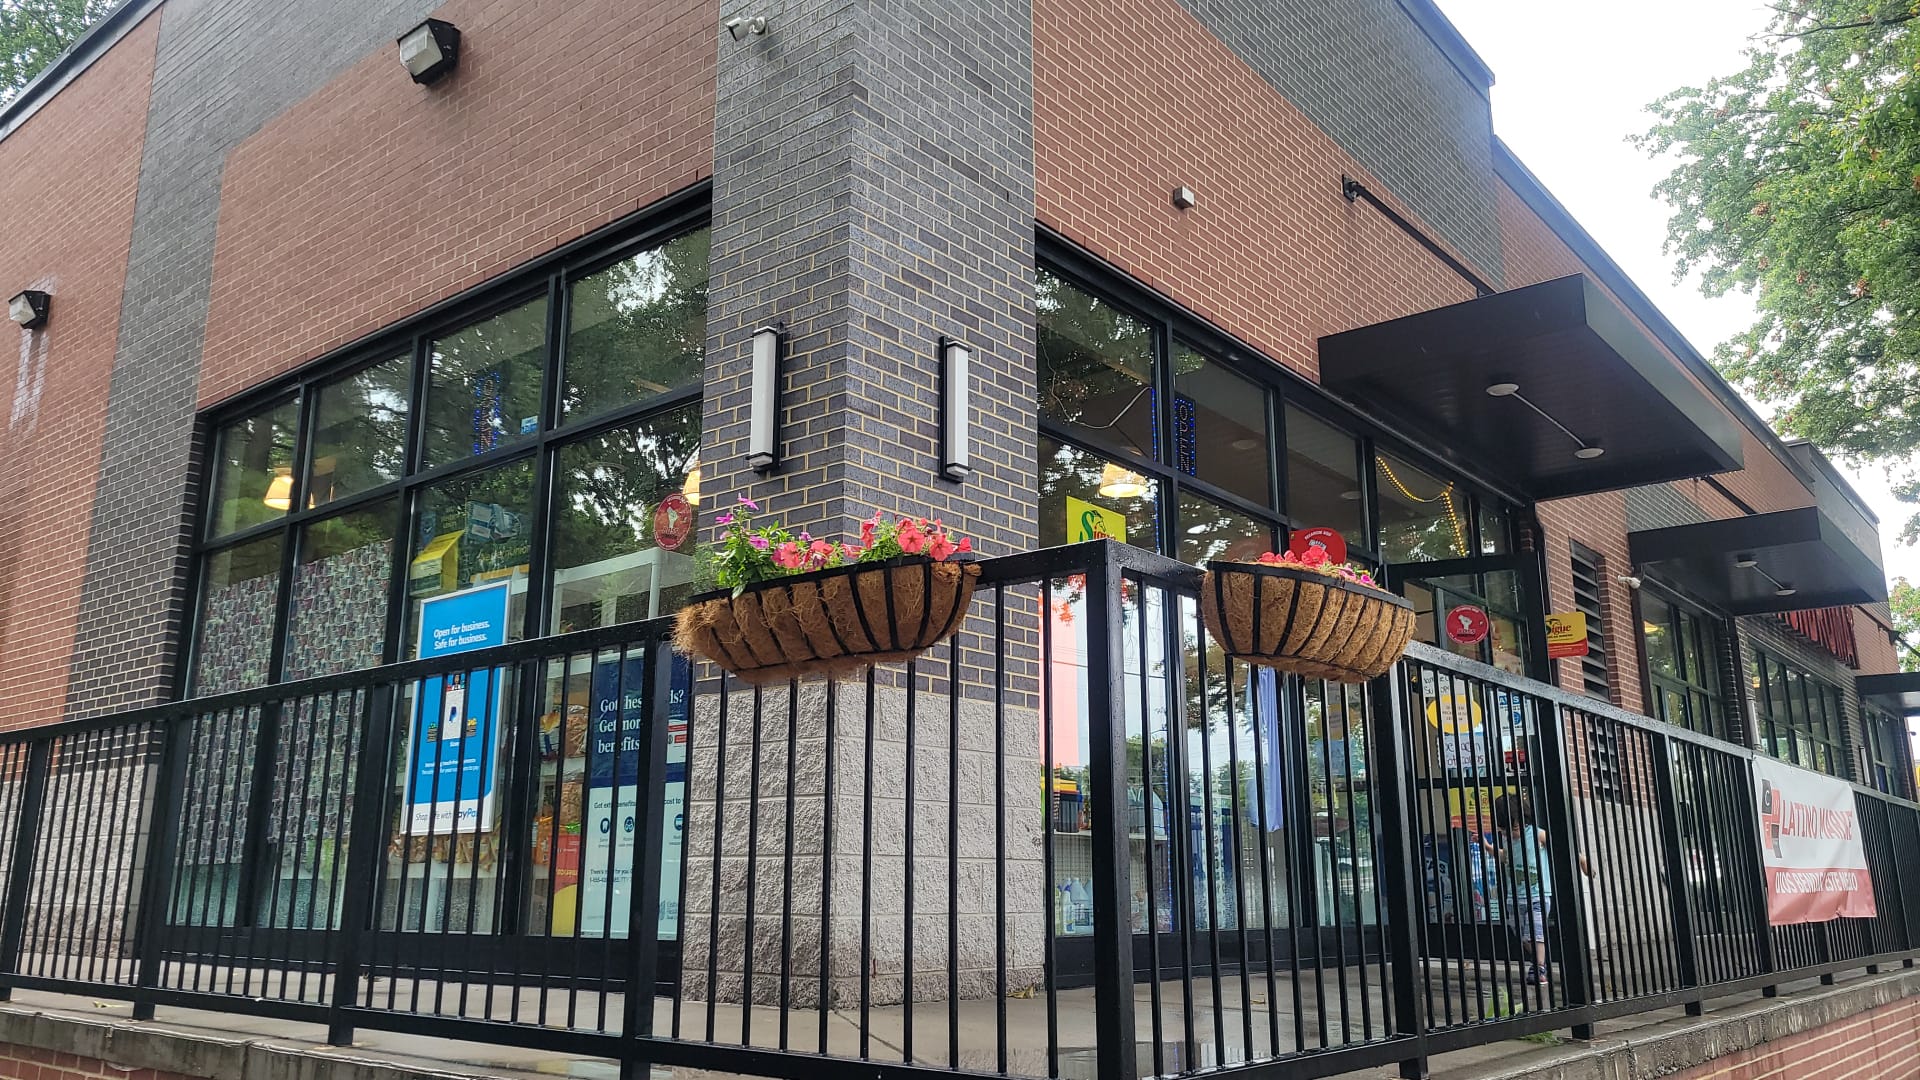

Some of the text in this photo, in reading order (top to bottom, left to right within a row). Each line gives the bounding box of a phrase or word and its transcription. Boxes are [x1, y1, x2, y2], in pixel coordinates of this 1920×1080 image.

[434, 620, 490, 640] Open for business.
[434, 633, 488, 650] Safe for business.
[600, 698, 619, 713] Got
[599, 719, 617, 733] Get
[598, 736, 641, 754] benfits
[1782, 800, 1818, 840] LATINO
